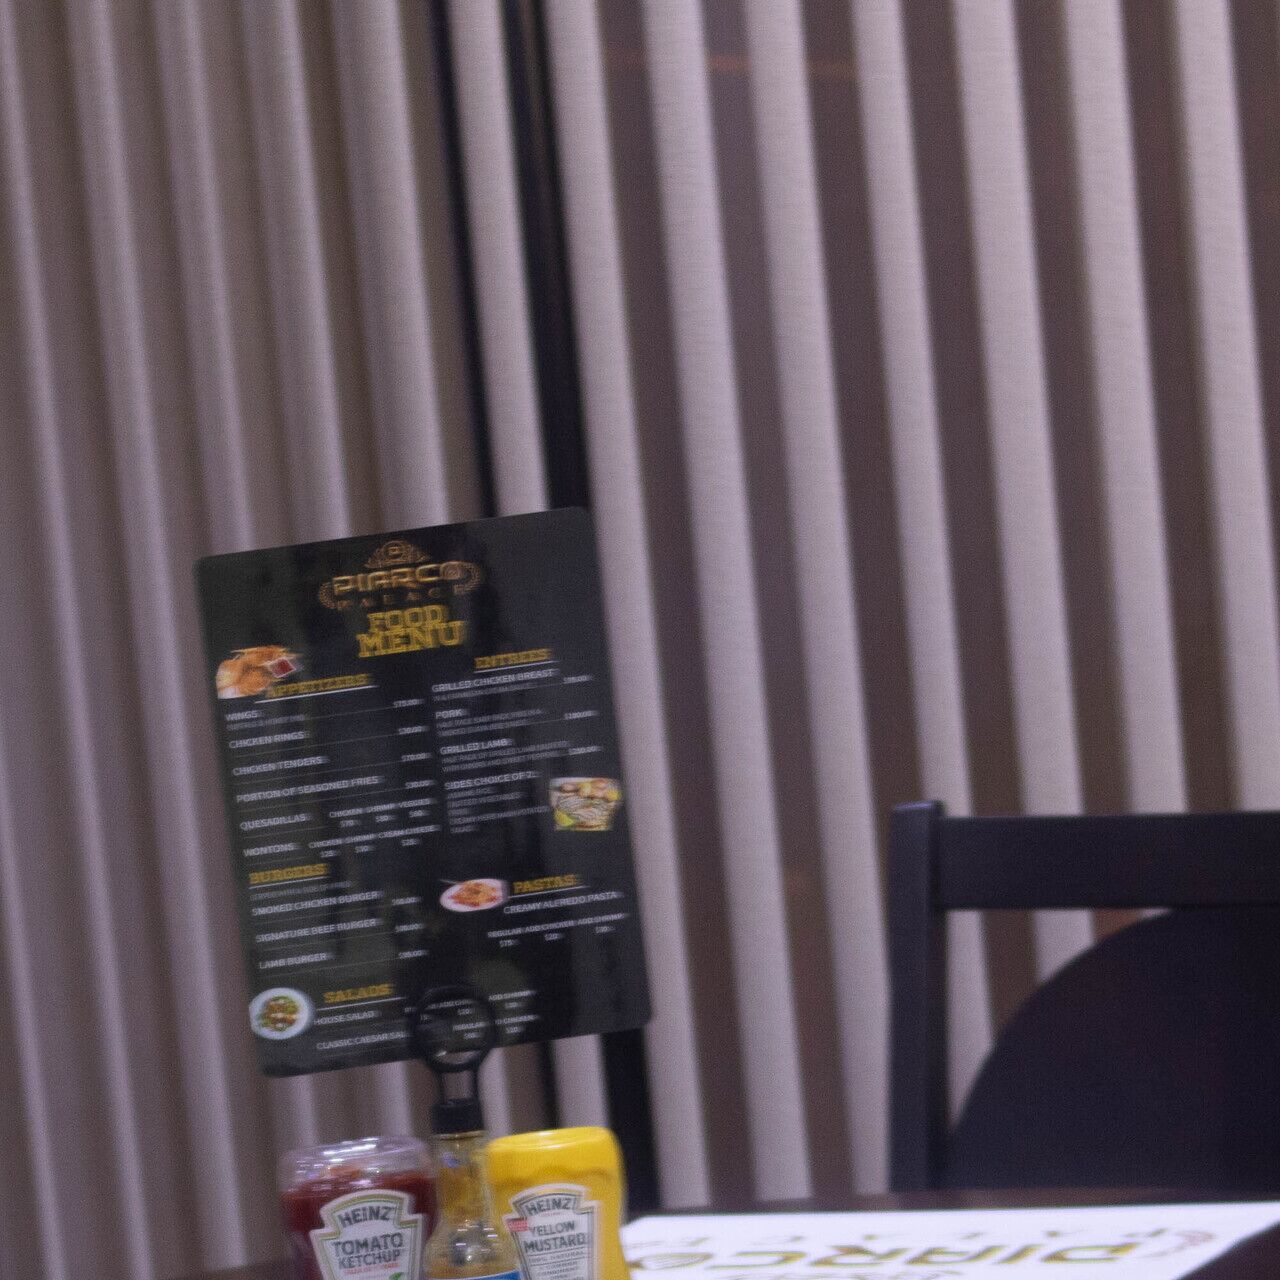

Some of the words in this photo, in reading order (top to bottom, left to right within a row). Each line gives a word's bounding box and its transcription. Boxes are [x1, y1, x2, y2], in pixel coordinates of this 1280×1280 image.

[333, 562, 462, 596] PIARCO
[367, 606, 444, 633] FOOD
[356, 622, 463, 658] MENU
[474, 649, 550, 669] ENTREES
[265, 675, 368, 698] APPETIZERS
[431, 681, 473, 693] GRILLED
[473, 675, 517, 687] CHICKEN
[518, 670, 555, 681] BREAST
[225, 711, 260, 722] WINGS
[435, 710, 464, 720] PORK
[229, 737, 273, 749] CHICKEN
[274, 732, 306, 743] RINGS
[440, 744, 482, 755] GRILLED
[482, 739, 510, 749] LAMB
[232, 764, 277, 776] CHICKEN
[277, 757, 324, 770] TENDERS
[236, 791, 282, 803] PORTION
[282, 788, 297, 797] OF
[297, 781, 351, 795] SEASONED
[351, 777, 380, 787] FRIES
[444, 781, 474, 790] SIDES
[475, 775, 511, 786] CHOICE
[240, 814, 308, 831] QUESADILLAS
[328, 809, 365, 819] CHICKEN
[243, 844, 296, 858] WONTONS
[308, 839, 344, 849] CHICKEN
[249, 865, 327, 884] BURGERS
[513, 875, 576, 894] PASTAS
[251, 904, 294, 917] SMOKED
[294, 898, 338, 910] CHICKEN
[339, 892, 380, 904] BURGER
[503, 903, 543, 915] CREAMY
[543, 897, 588, 909] ALFREDO
[588, 893, 619, 902] PASTA
[255, 929, 311, 943] SIGNATURE
[311, 925, 336, 935] BEEF
[337, 919, 378, 931] BURGER
[487, 928, 524, 939] REGULAR
[541, 921, 576, 931] CHICKEN
[259, 957, 288, 970] LAMB
[288, 954, 329, 966] BURGER
[323, 985, 391, 1003] SALADS
[313, 1015, 347, 1026] HOUSE
[347, 1012, 376, 1022] SALAD
[317, 1039, 355, 1051] CLASSIC
[355, 1034, 390, 1045] CAESAR
[390, 1032, 408, 1040] SAL
[527, 1198, 574, 1216] HEINZ
[339, 1205, 392, 1229] HEINZ
[531, 1221, 576, 1237] YELLOW
[333, 1233, 404, 1260] TOMATO
[524, 1235, 586, 1254] MUSTARD
[339, 1250, 401, 1270] KETCHUP
